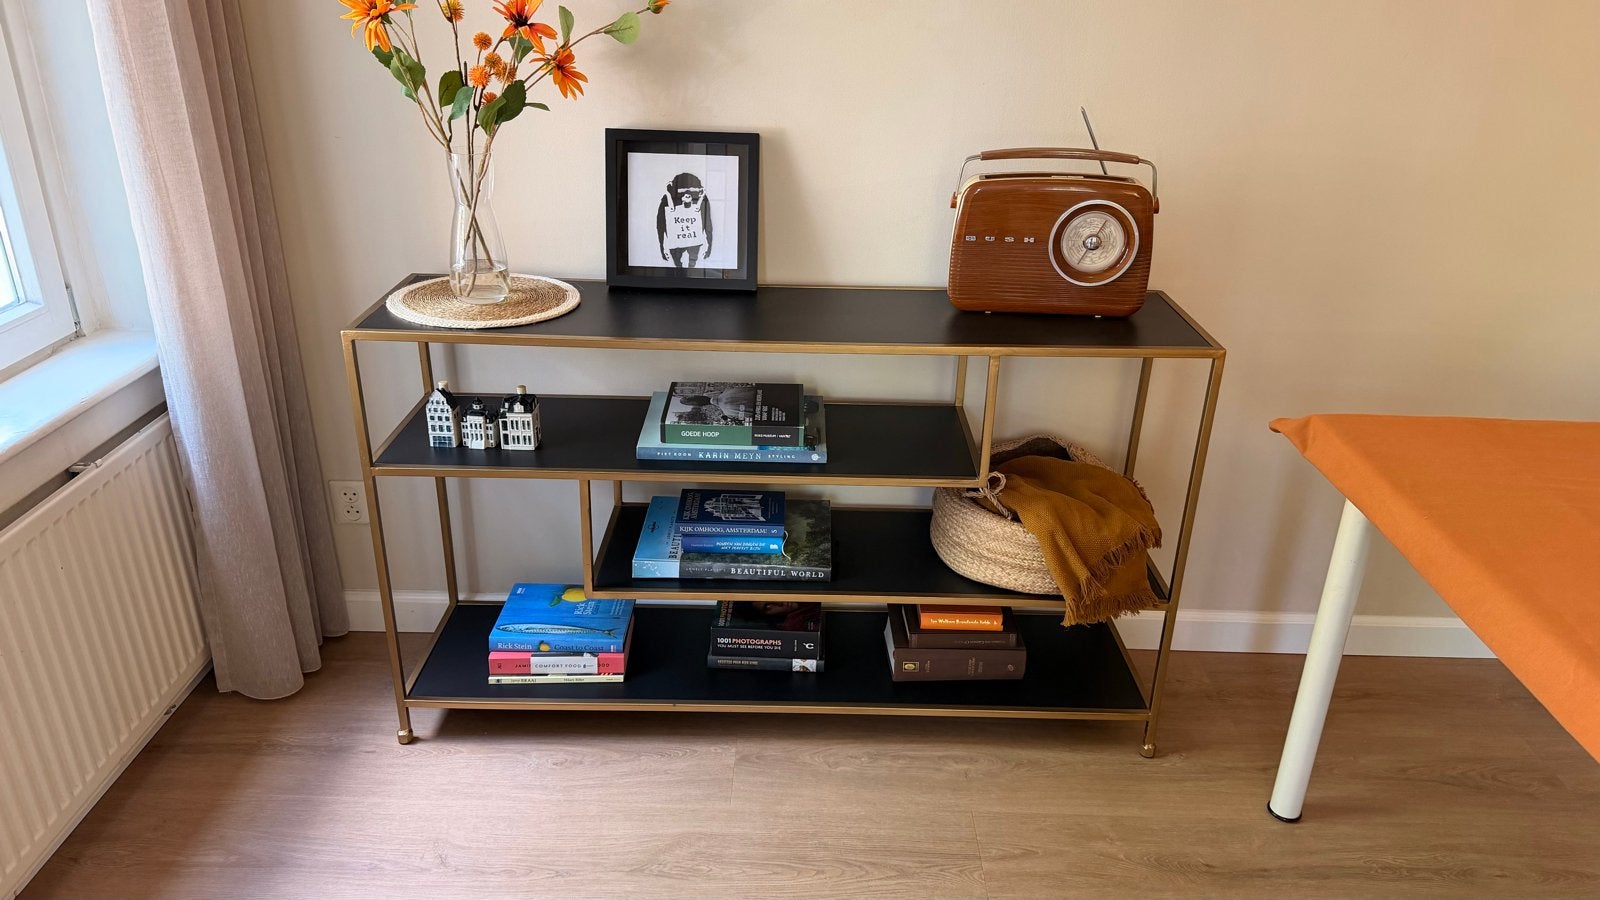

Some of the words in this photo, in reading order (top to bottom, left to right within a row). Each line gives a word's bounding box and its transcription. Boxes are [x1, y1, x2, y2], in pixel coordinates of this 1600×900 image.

[674, 217, 696, 225] Keep
[965, 235, 1035, 243] BUSH
[731, 567, 786, 576] BEAUTIFUL
